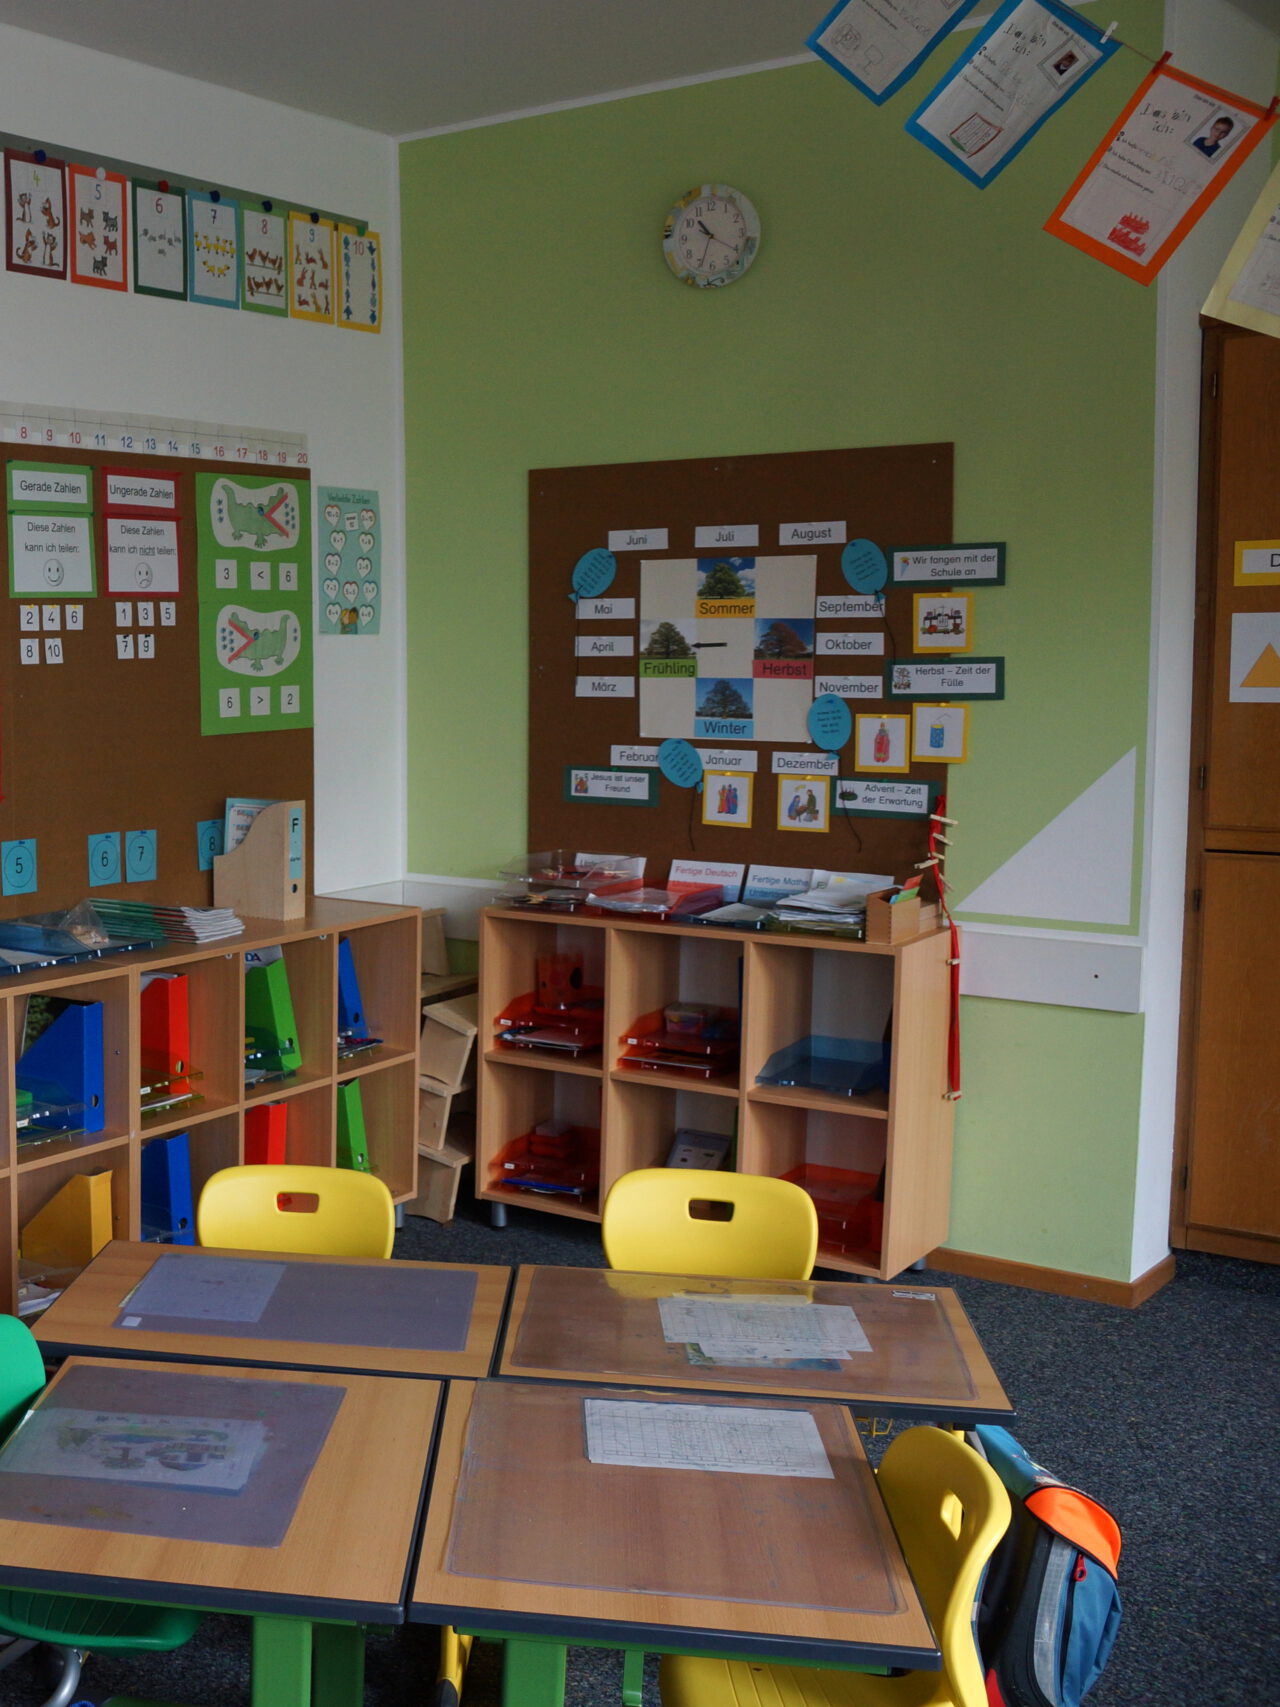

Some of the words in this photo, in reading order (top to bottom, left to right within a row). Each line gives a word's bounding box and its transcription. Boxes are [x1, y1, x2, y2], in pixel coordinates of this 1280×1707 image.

[32, 170, 41, 186] 4
[95, 184, 102, 200] 5
[155, 197, 163, 214] 6
[210, 209, 218, 224] 7
[261, 218, 268, 235] 8
[308, 228, 315, 243] 9
[352, 240, 364, 257] 10
[20, 480, 52, 492] Gerade
[54, 482, 82, 494] Zahlen
[109, 484, 148, 497] Ungerade
[149, 487, 173, 499] Zahlen
[27, 522, 50, 533] Diese
[51, 523, 76, 534] Zahlen
[120, 525, 140, 535] Diese
[141, 526, 165, 536] Zahlen
[791, 527, 832, 541] August
[626, 535, 648, 547] Juni
[715, 531, 735, 543] Juli
[24, 543, 44, 552] kann
[45, 543, 56, 552] ich
[58, 544, 80, 553] teilen:
[109, 544, 126, 554] kann
[127, 545, 138, 554] ich
[139, 546, 156, 556] nicht
[912, 557, 929, 565] Wir
[930, 556, 962, 566] fangen
[963, 554, 979, 564] mit
[980, 553, 996, 564] der
[223, 568, 230, 580] 3
[285, 571, 292, 582] 6
[930, 567, 962, 577] Schule
[964, 568, 976, 577] an
[121, 609, 127, 621] 1
[143, 608, 149, 621] 3
[165, 607, 171, 620] 5
[594, 603, 614, 615] Mai
[699, 602, 755, 616] Sommer
[819, 600, 884, 615] September
[26, 611, 34, 624] 2
[48, 611, 55, 624] 4
[71, 611, 78, 624] 6
[26, 645, 34, 658] 8
[48, 644, 61, 657] 10
[122, 641, 128, 653] 7
[143, 640, 150, 652] 9
[591, 641, 615, 654] April
[825, 639, 873, 651] Oktober
[643, 662, 696, 678] Frühling
[762, 662, 807, 676] Herbst
[915, 667, 945, 675] Herbst
[955, 666, 973, 675] Zeit
[974, 666, 991, 675] der
[591, 681, 617, 693] März
[819, 681, 879, 694] November
[941, 677, 964, 687] Fülle
[227, 697, 233, 708] 6
[287, 693, 293, 705] 2
[703, 720, 747, 735] Winter
[620, 751, 659, 763] Februar
[705, 754, 742, 767] Januar
[777, 757, 835, 771] Dezember
[605, 784, 631, 793] Freund
[864, 784, 895, 794] Advent
[904, 785, 922, 795] Zeit
[292, 817, 299, 833] F
[209, 836, 216, 851] 8
[101, 851, 109, 868] 6
[137, 846, 145, 863] 7
[15, 857, 23, 874] 5
[675, 865, 703, 877] Fertige
[705, 867, 738, 879] Deutsch
[752, 875, 781, 887] Fertige
